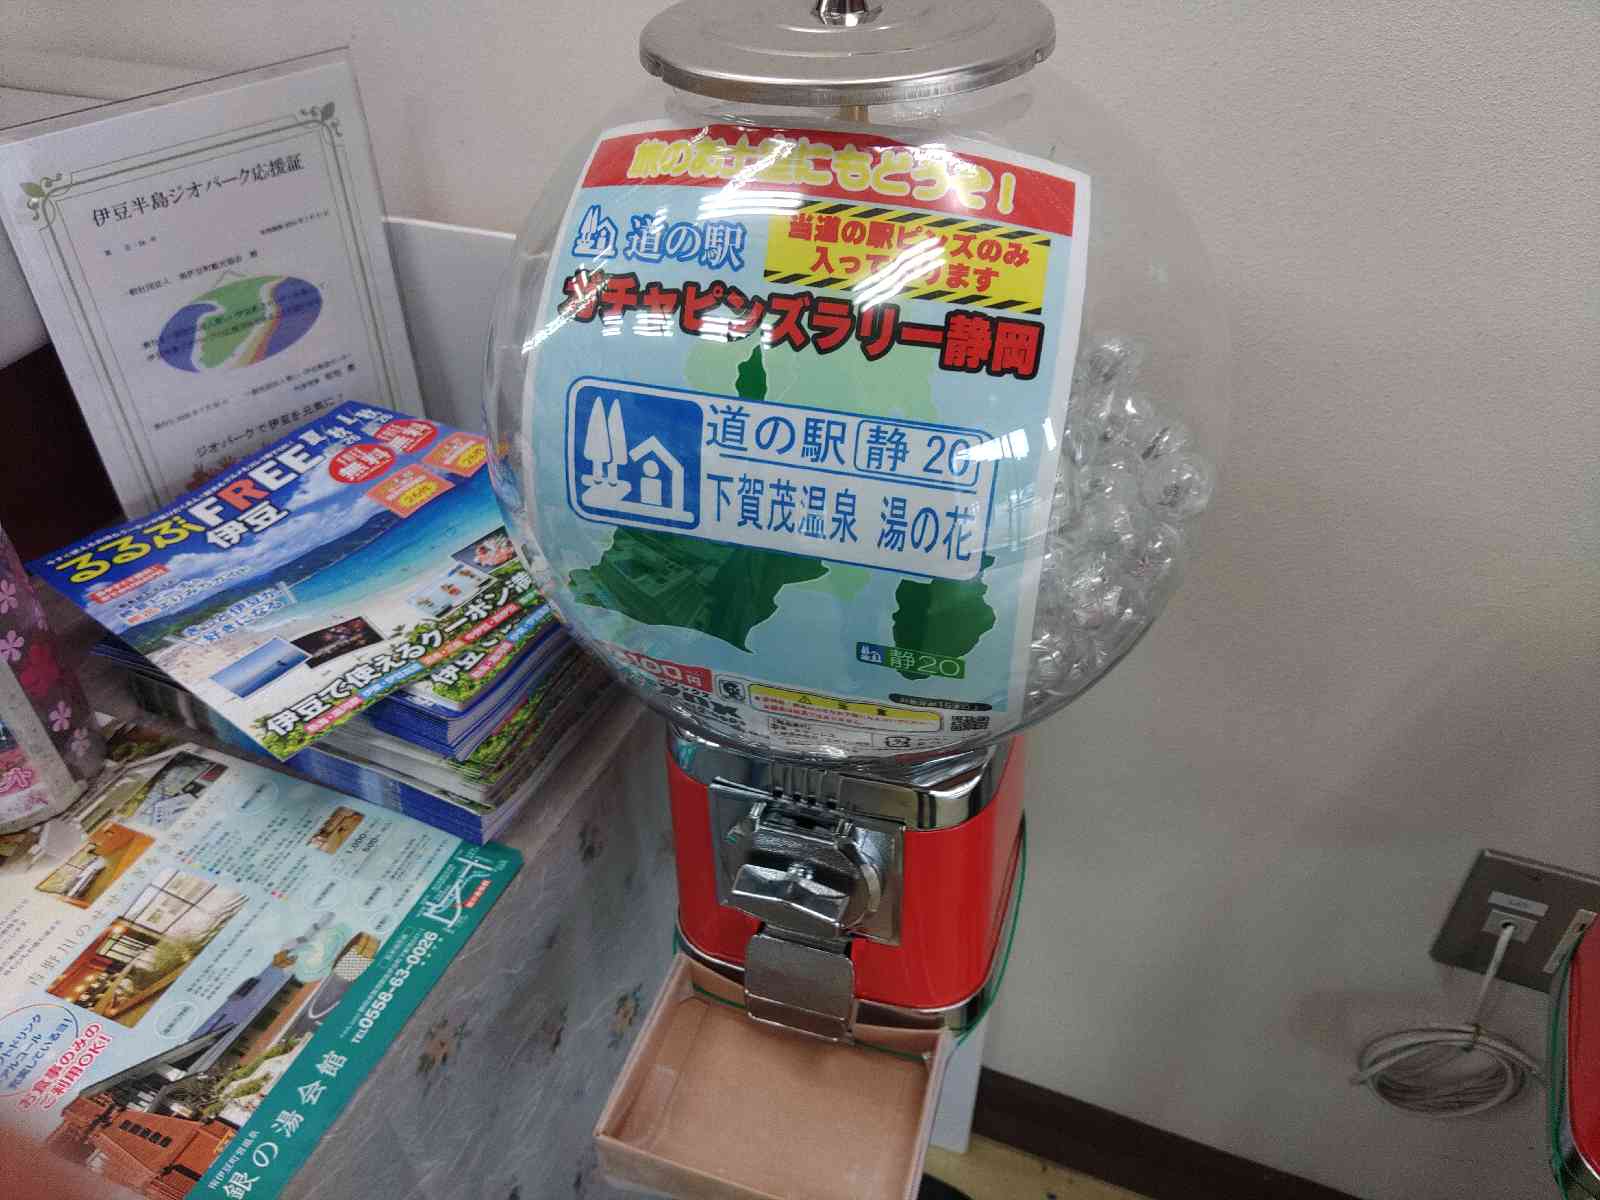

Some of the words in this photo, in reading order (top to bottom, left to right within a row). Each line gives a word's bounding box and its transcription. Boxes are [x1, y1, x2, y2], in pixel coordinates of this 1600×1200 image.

[625, 213, 746, 272] 道の駅
[706, 403, 846, 467] 道の駅
[865, 424, 910, 474] 静
[206, 501, 291, 549] 伊豆
[706, 471, 860, 545] 下賀茂温泉
[876, 504, 973, 562] 湯の花
[890, 648, 961, 677] 静20
[222, 1050, 348, 1200] 銀の湯会館
